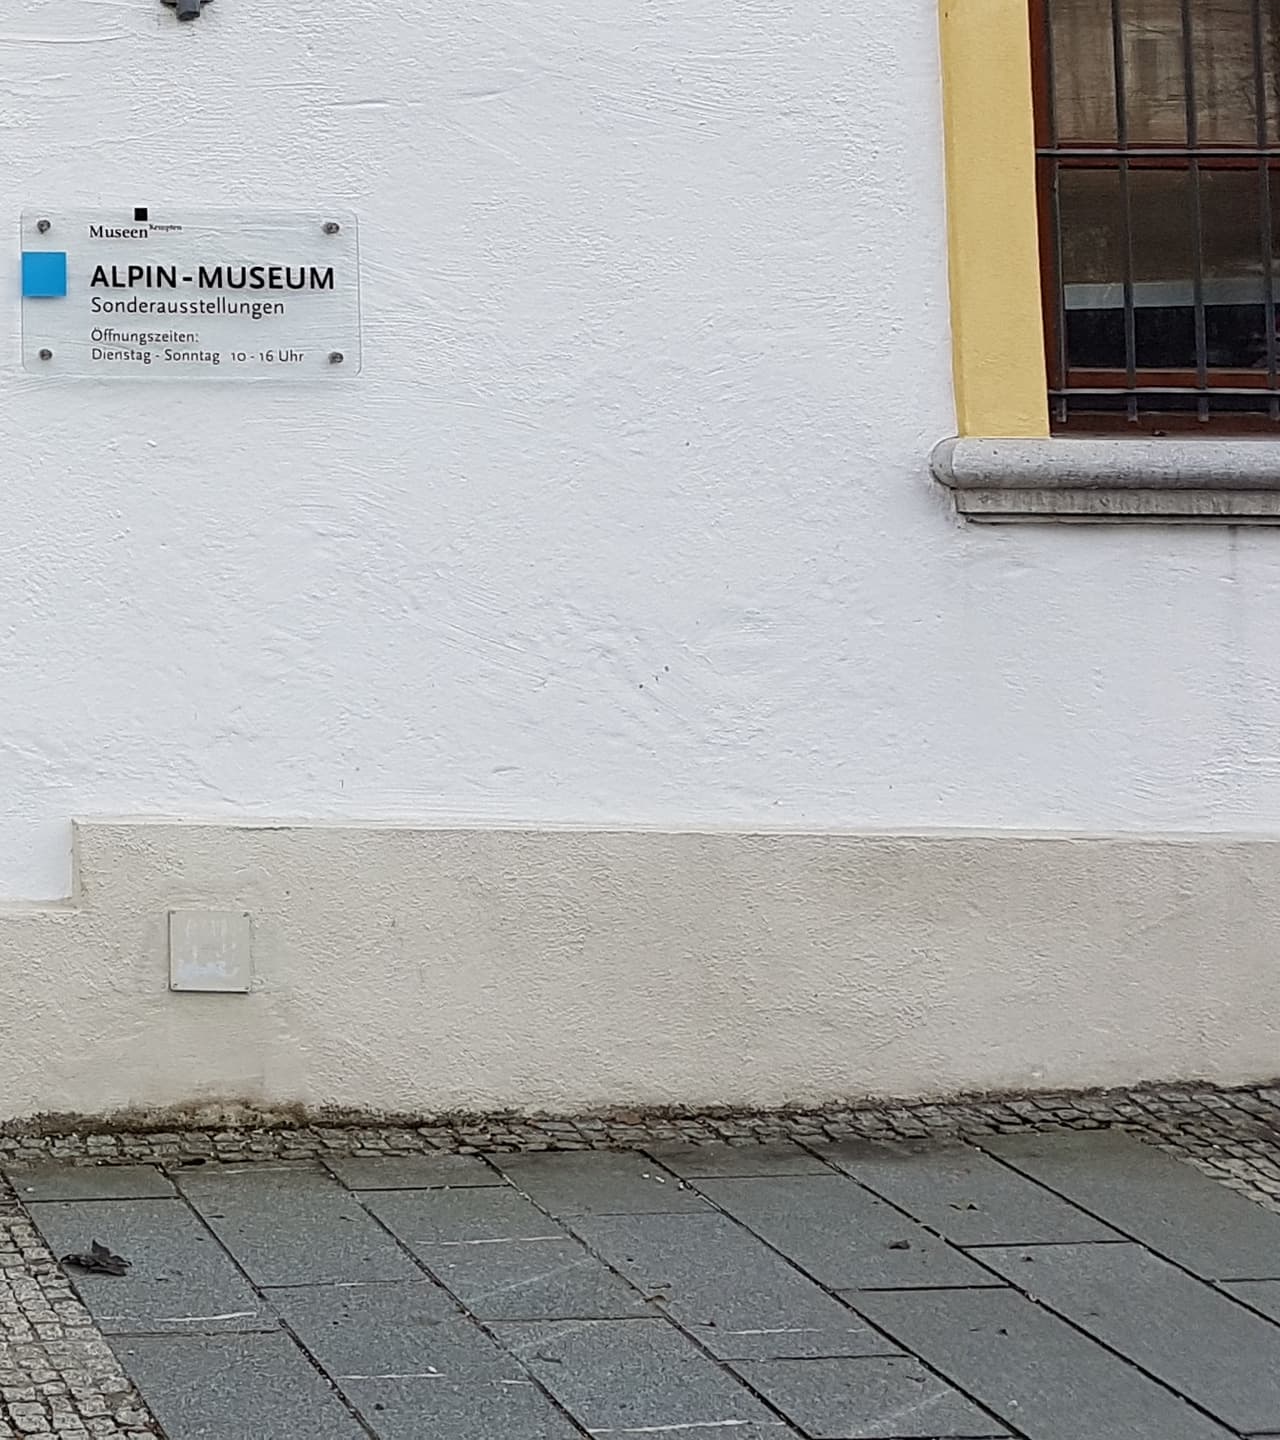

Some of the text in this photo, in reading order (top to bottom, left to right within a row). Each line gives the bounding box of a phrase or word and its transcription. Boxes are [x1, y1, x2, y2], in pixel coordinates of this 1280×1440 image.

[89, 225, 148, 239] Museen
[90, 265, 334, 290] ALPIN-MUSEUM
[91, 296, 285, 320] Sonderausstellungen
[91, 327, 199, 346] Öffnungszeiten:
[92, 348, 152, 365] Dienstag
[164, 348, 220, 366] Sonntag
[231, 352, 247, 362] 10
[259, 349, 274, 362] 16
[278, 349, 304, 362] Uhr
